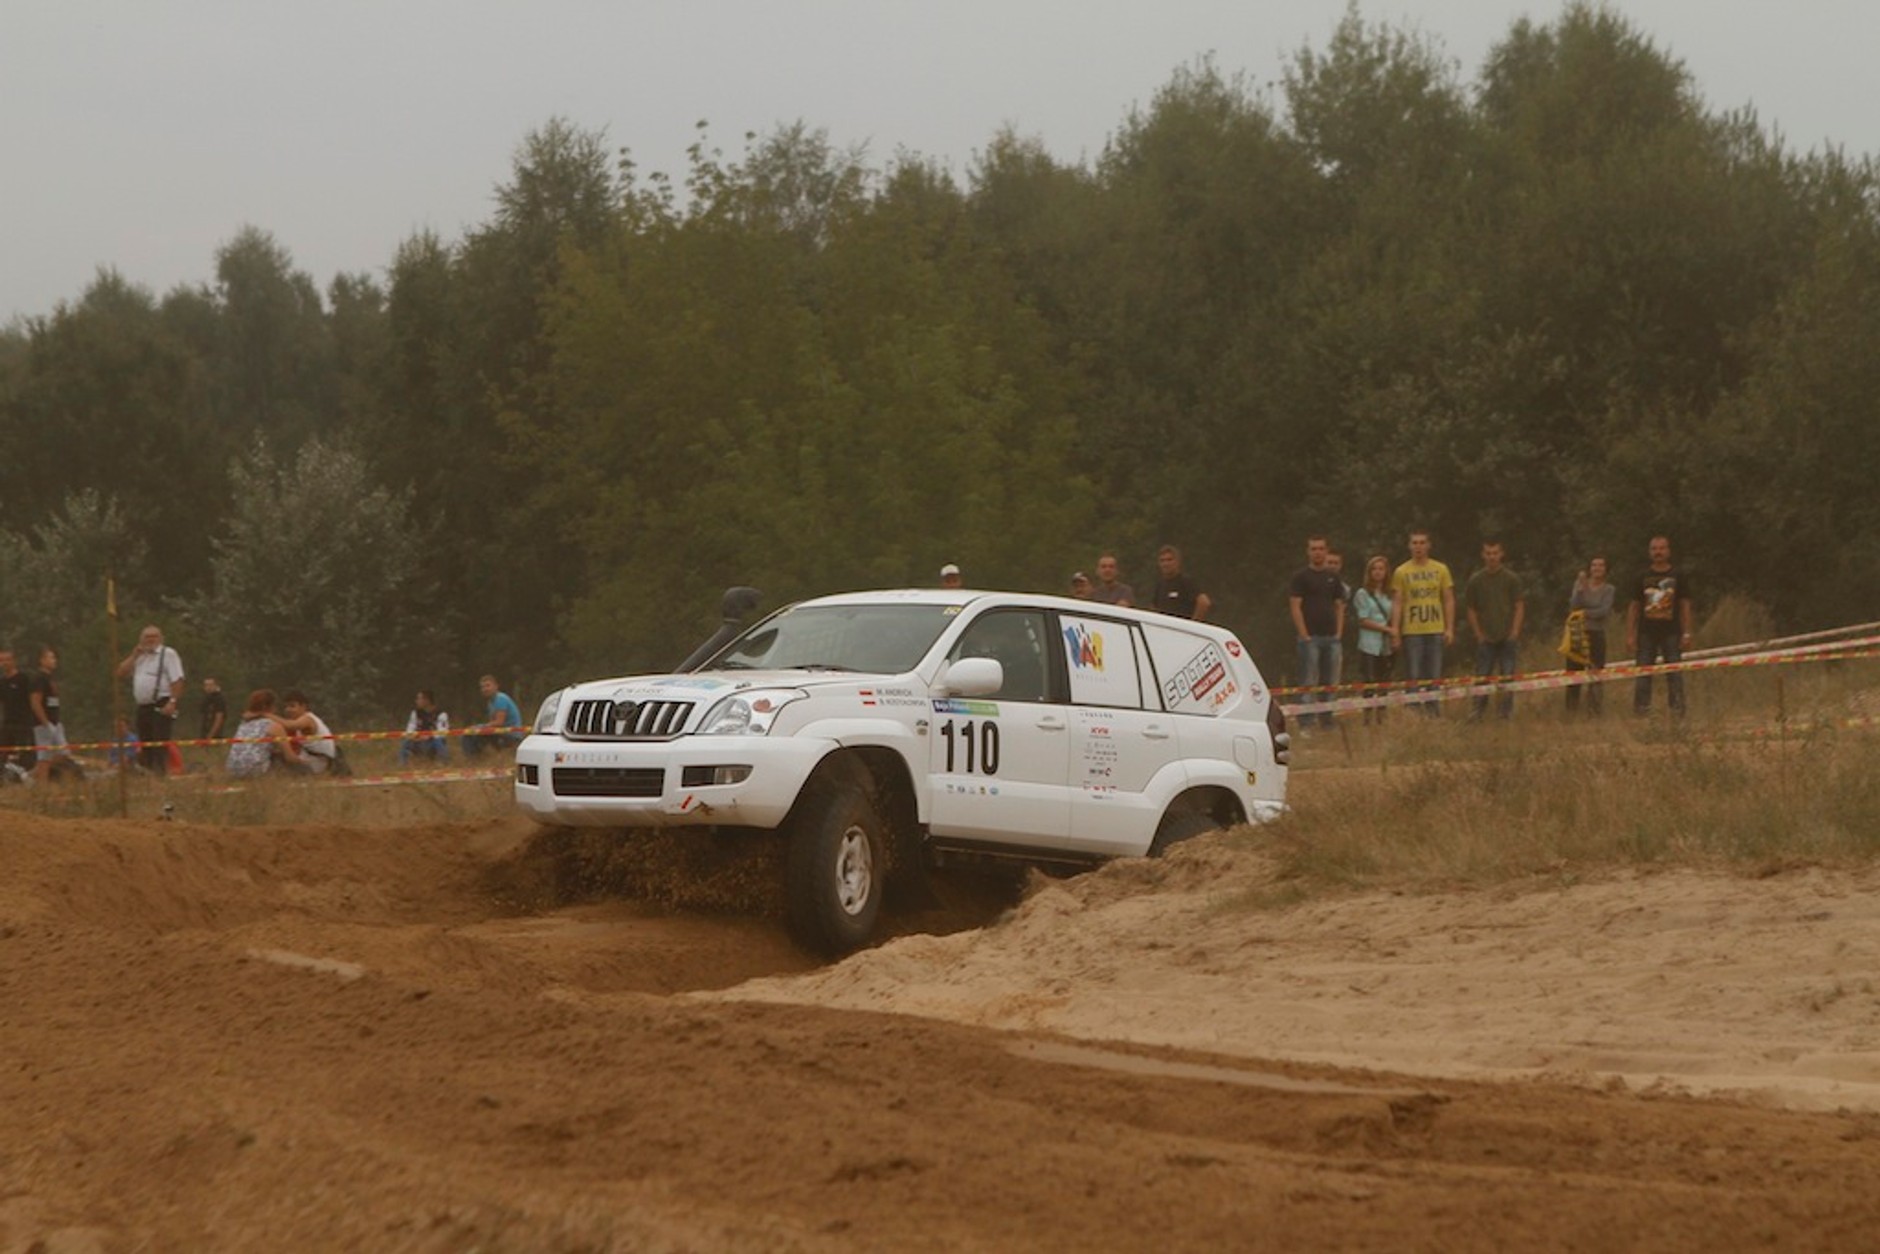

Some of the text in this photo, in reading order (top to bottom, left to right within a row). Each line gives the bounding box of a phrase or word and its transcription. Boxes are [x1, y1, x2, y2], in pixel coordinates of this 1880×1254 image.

[1411, 570, 1440, 581] WANT
[1410, 587, 1438, 599] MORE
[1409, 604, 1441, 624] FUN
[941, 719, 999, 776] 110
